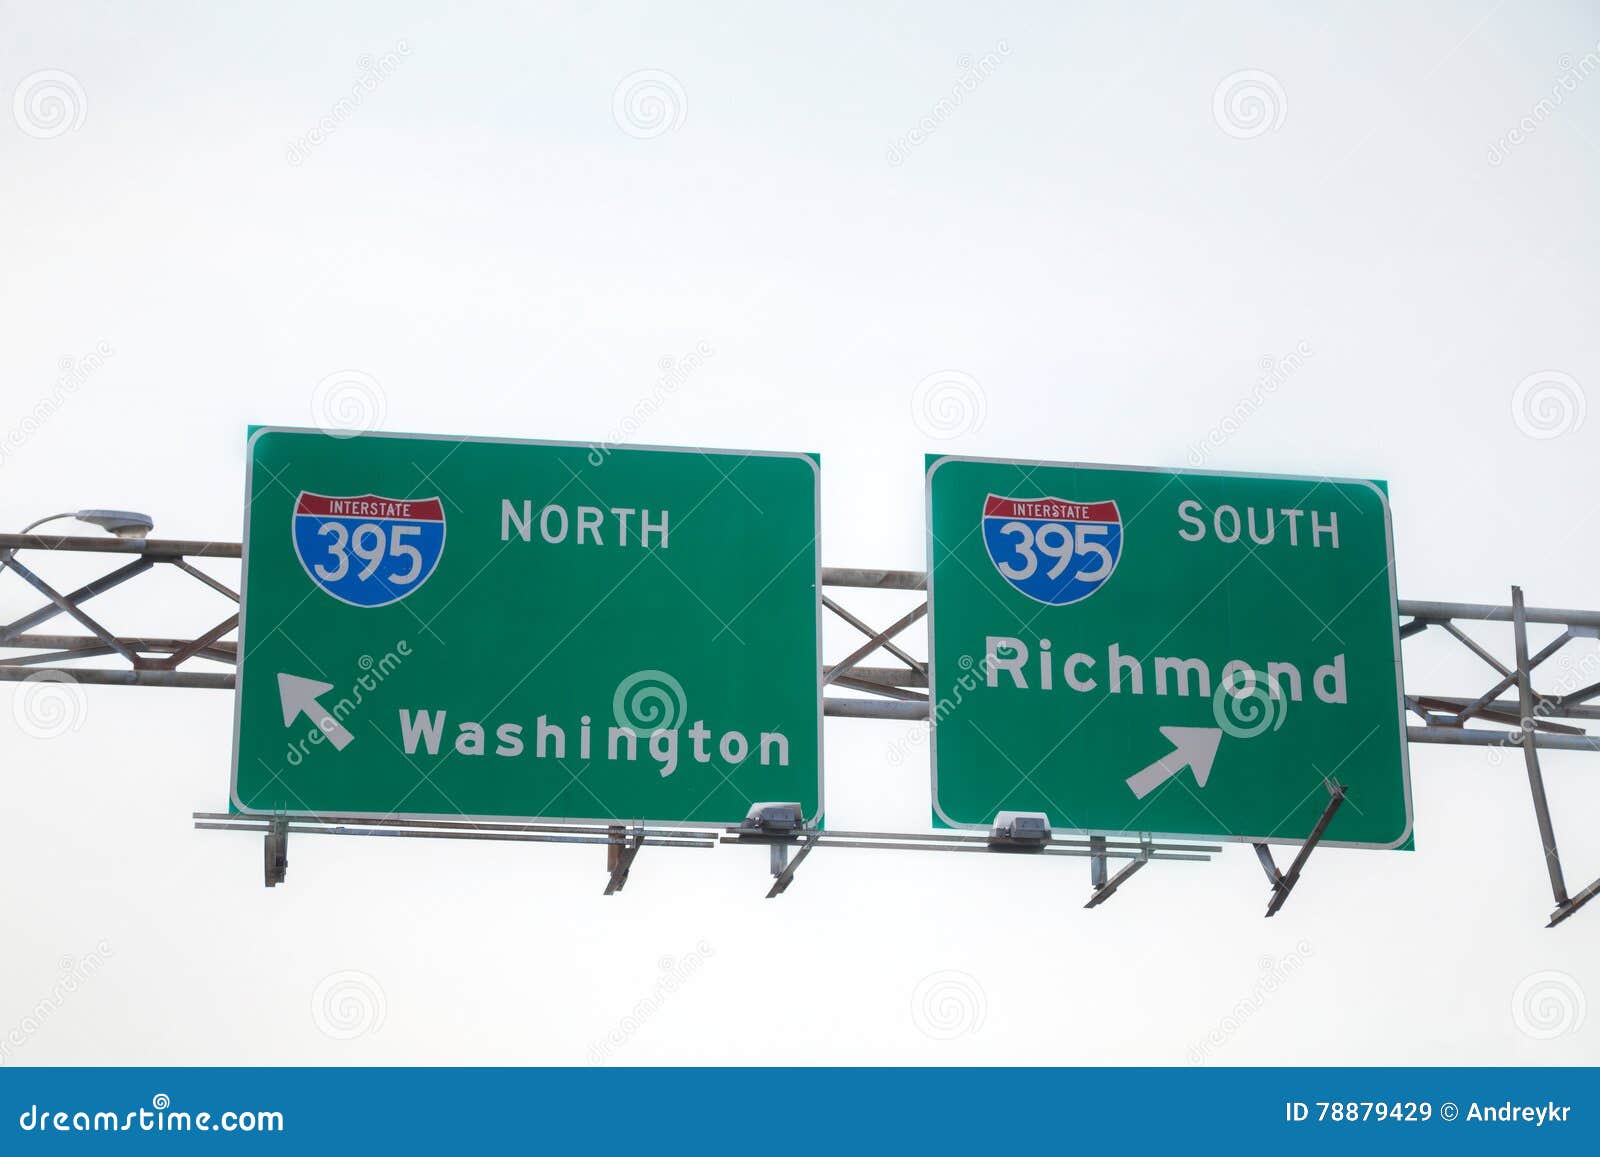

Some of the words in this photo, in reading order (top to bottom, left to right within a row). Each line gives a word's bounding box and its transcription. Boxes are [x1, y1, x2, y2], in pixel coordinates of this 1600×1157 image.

[329, 499, 412, 518] INTERSTATE
[501, 499, 669, 549] NORTH
[1013, 502, 1090, 520] INTERSTATE
[1178, 500, 1340, 549] SOUTH
[314, 522, 423, 585] 395
[998, 522, 1113, 582] 395
[986, 635, 1348, 704] Richmond
[399, 708, 790, 778] Washington
